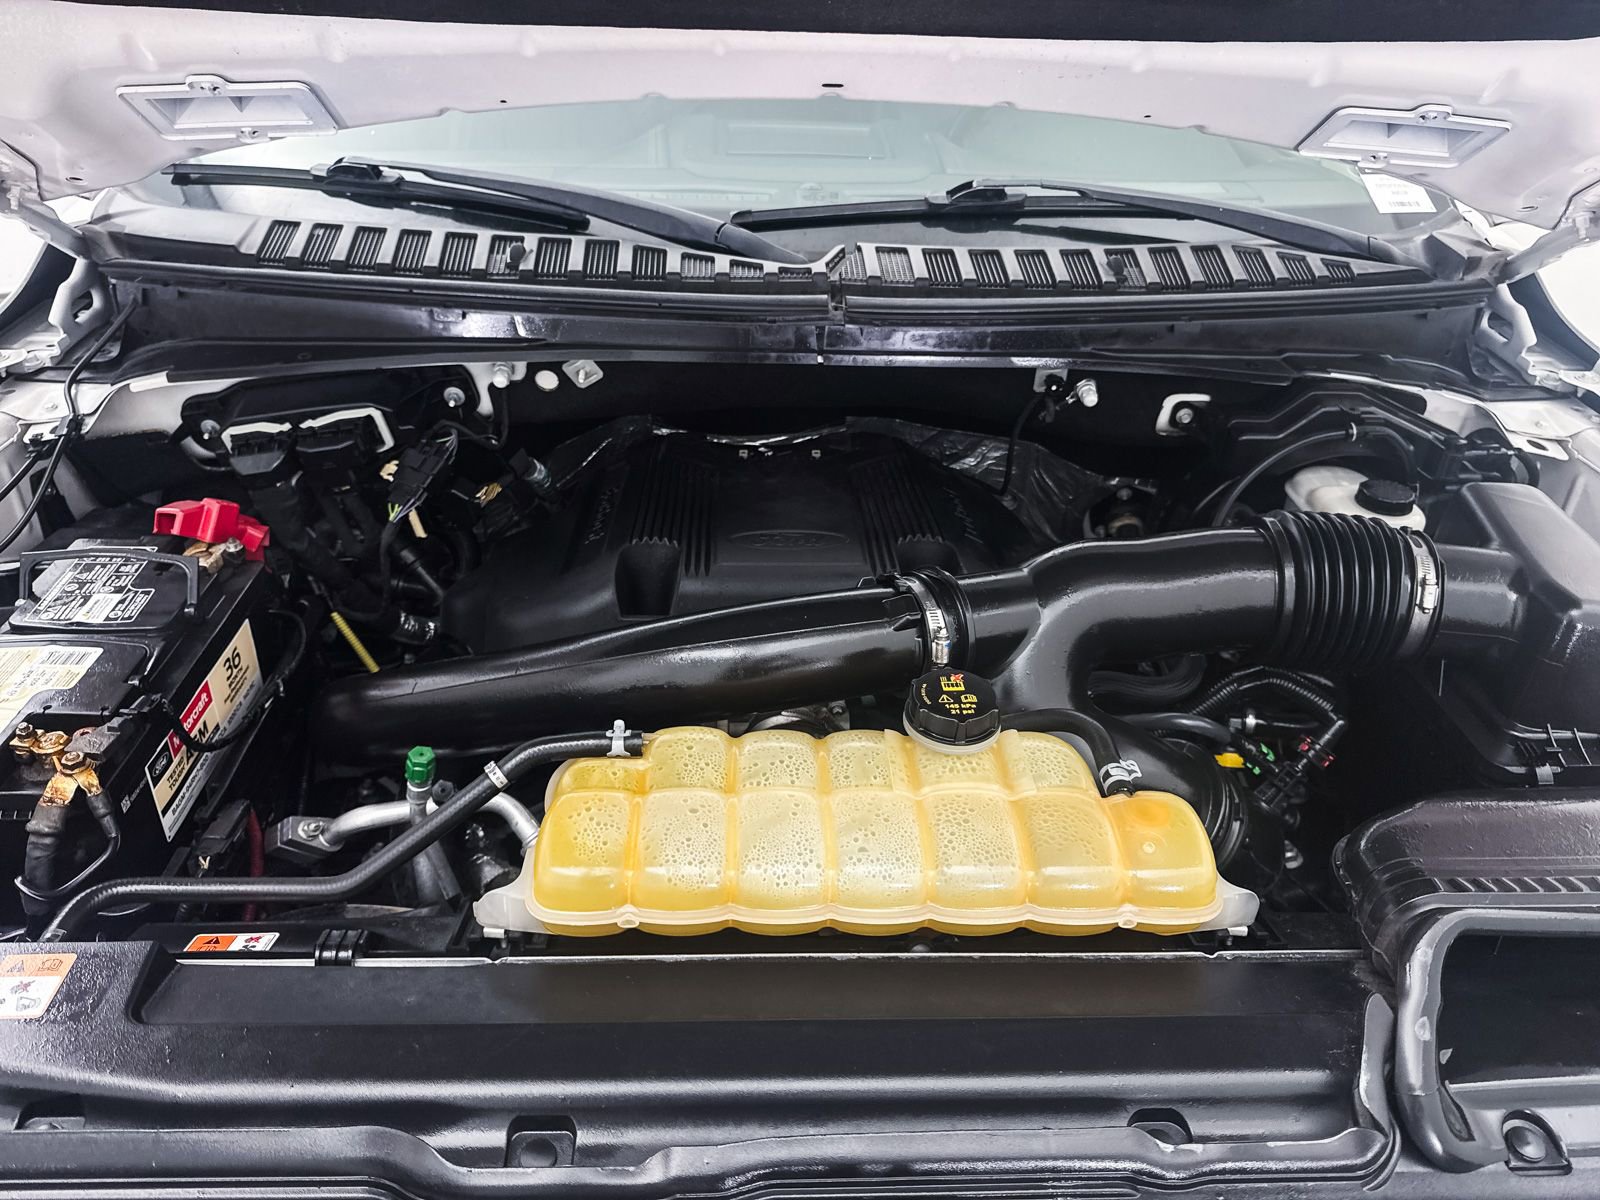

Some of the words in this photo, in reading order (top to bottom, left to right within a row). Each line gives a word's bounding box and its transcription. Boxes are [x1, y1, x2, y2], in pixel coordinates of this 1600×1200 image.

[223, 646, 242, 682] 36
[172, 692, 209, 750] Mtorcraft
[167, 756, 185, 784] TESTED
